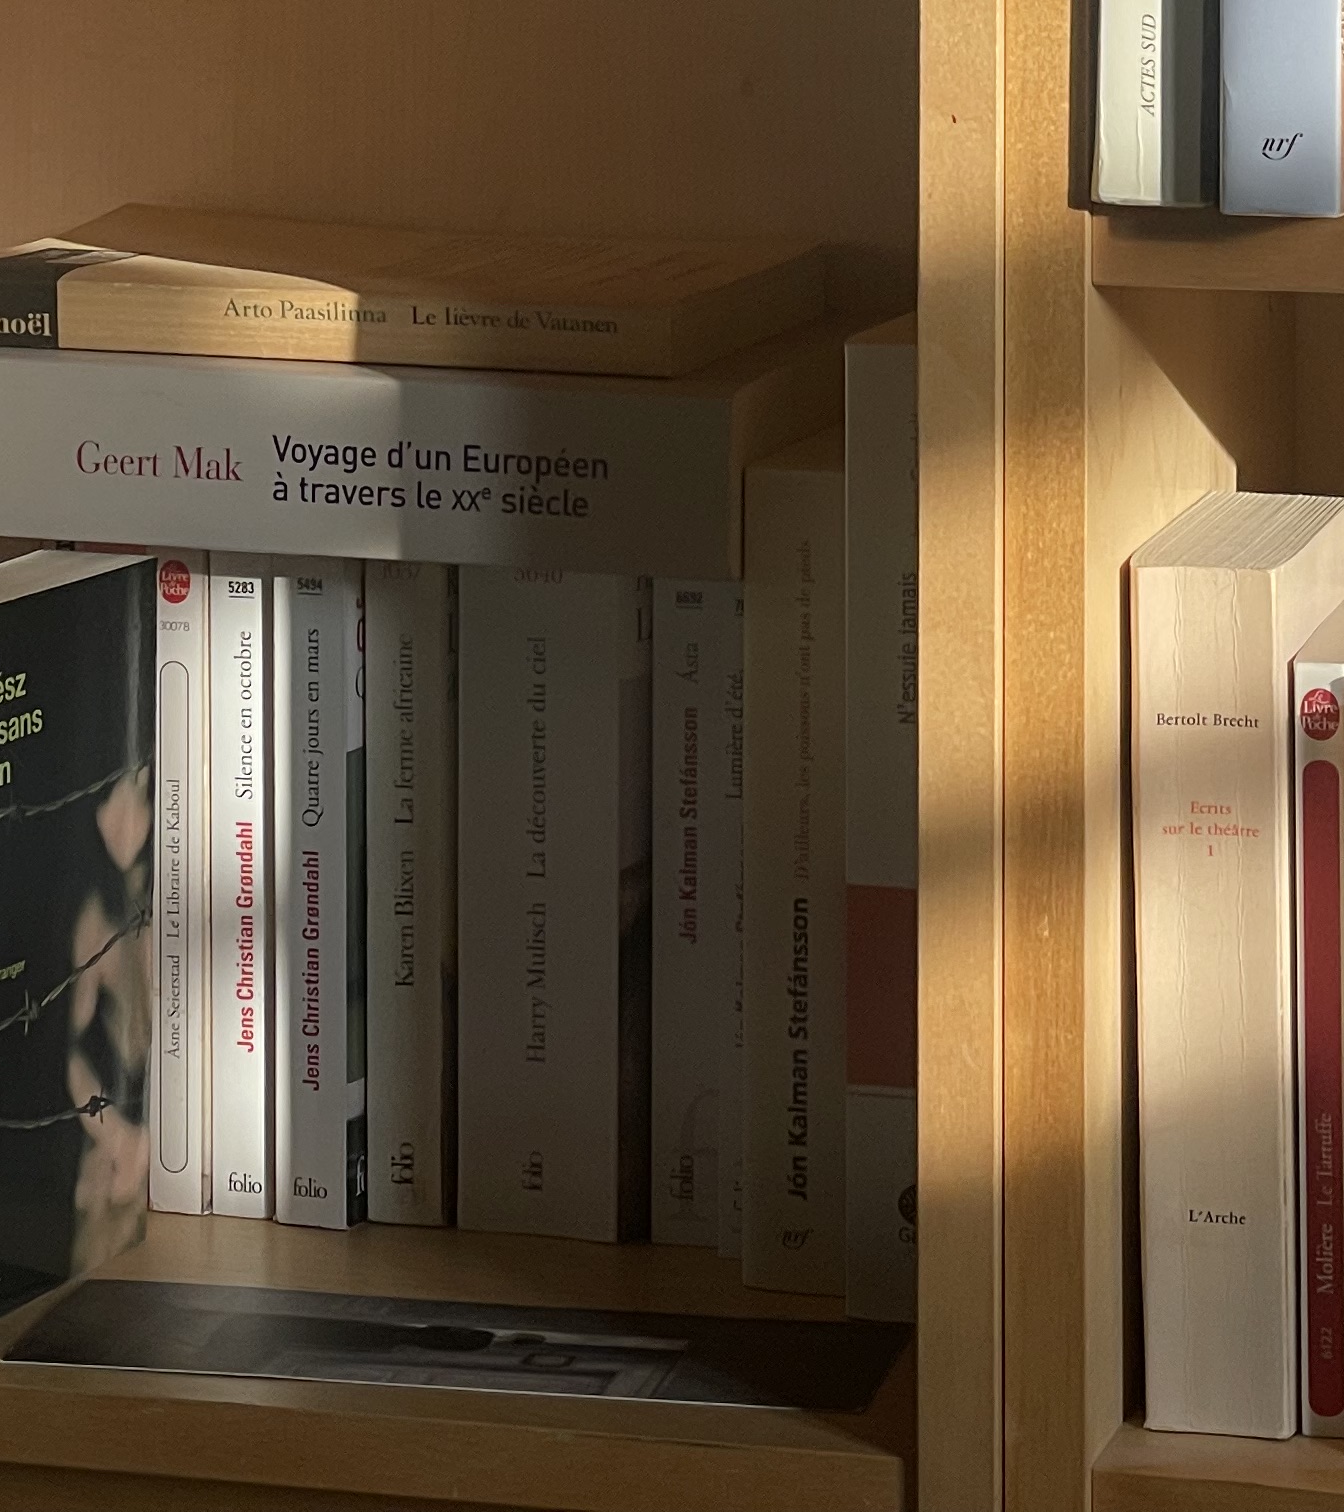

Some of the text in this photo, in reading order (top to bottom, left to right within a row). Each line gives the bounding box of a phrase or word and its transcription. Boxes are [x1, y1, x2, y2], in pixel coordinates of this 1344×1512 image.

[77, 440, 243, 482] Geert Mak
[272, 435, 608, 484] Voyage d'un Européen
[228, 581, 255, 594] 5283
[1156, 713, 1259, 729] Bertolt Brecht
[1303, 700, 1338, 714] Livre
[234, 631, 254, 1053] Jens Christian Grøndahl Silence en octobre
[788, 897, 808, 1200] Jón Kalman Stefánsson
[391, 1141, 416, 1186] folio
[228, 1171, 262, 1194] folio
[293, 1176, 327, 1199] folio
